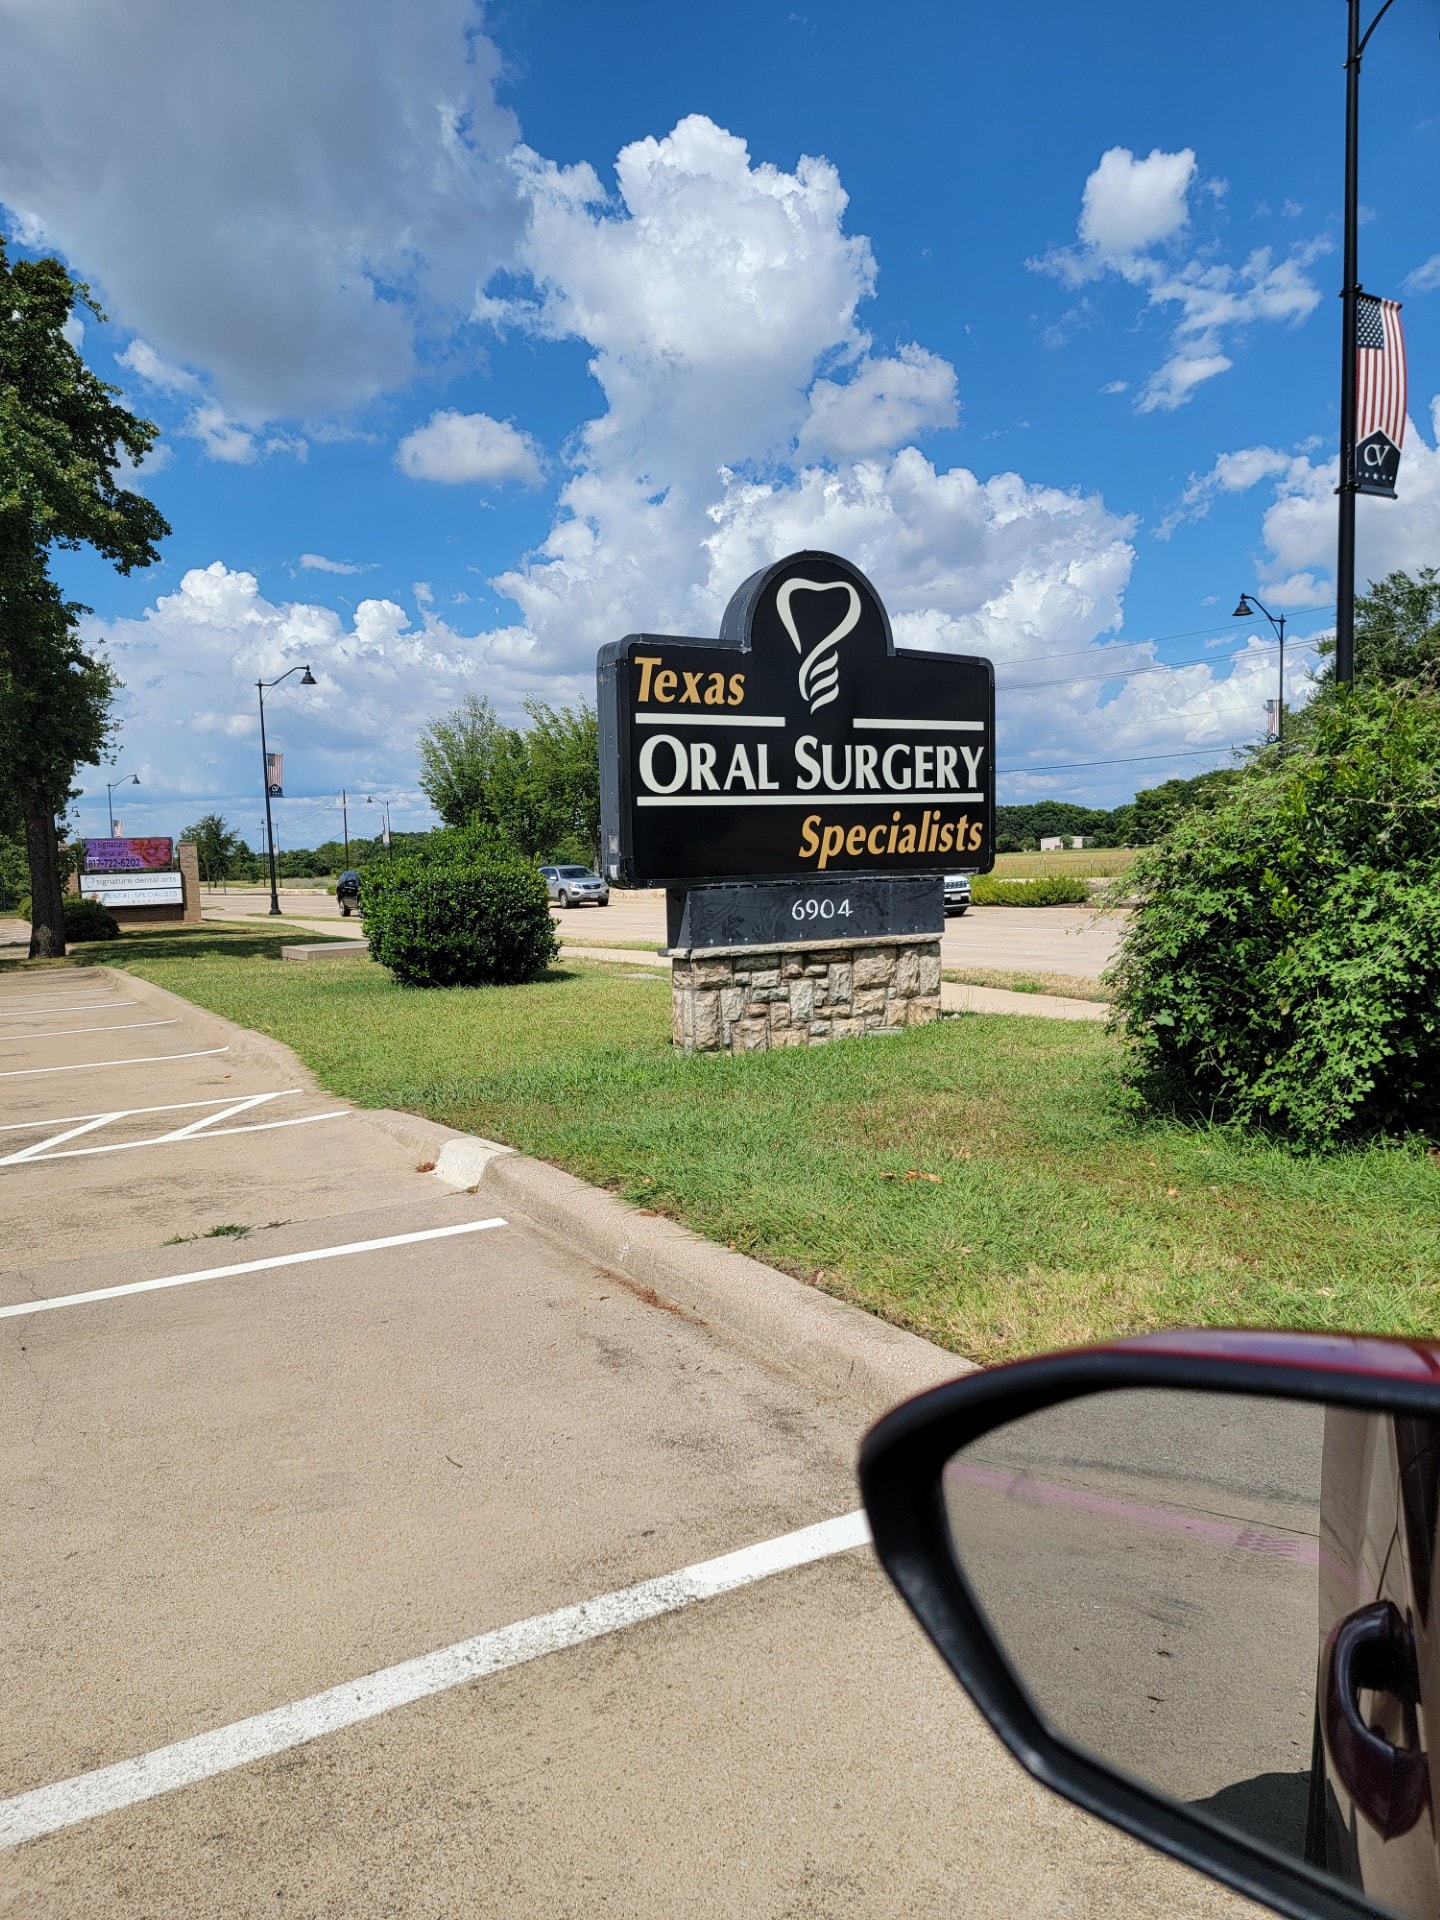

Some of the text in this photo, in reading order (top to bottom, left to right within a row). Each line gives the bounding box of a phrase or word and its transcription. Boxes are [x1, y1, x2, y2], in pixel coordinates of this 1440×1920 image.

[1363, 444, 1390, 467] CV
[634, 656, 745, 706] Texas
[638, 734, 984, 794] ORAL SURGERY
[799, 810, 983, 869] Specialists
[88, 858, 140, 868] 817-722-6202
[96, 876, 133, 886] signature
[135, 875, 159, 883] dental
[791, 898, 854, 921] 6904
